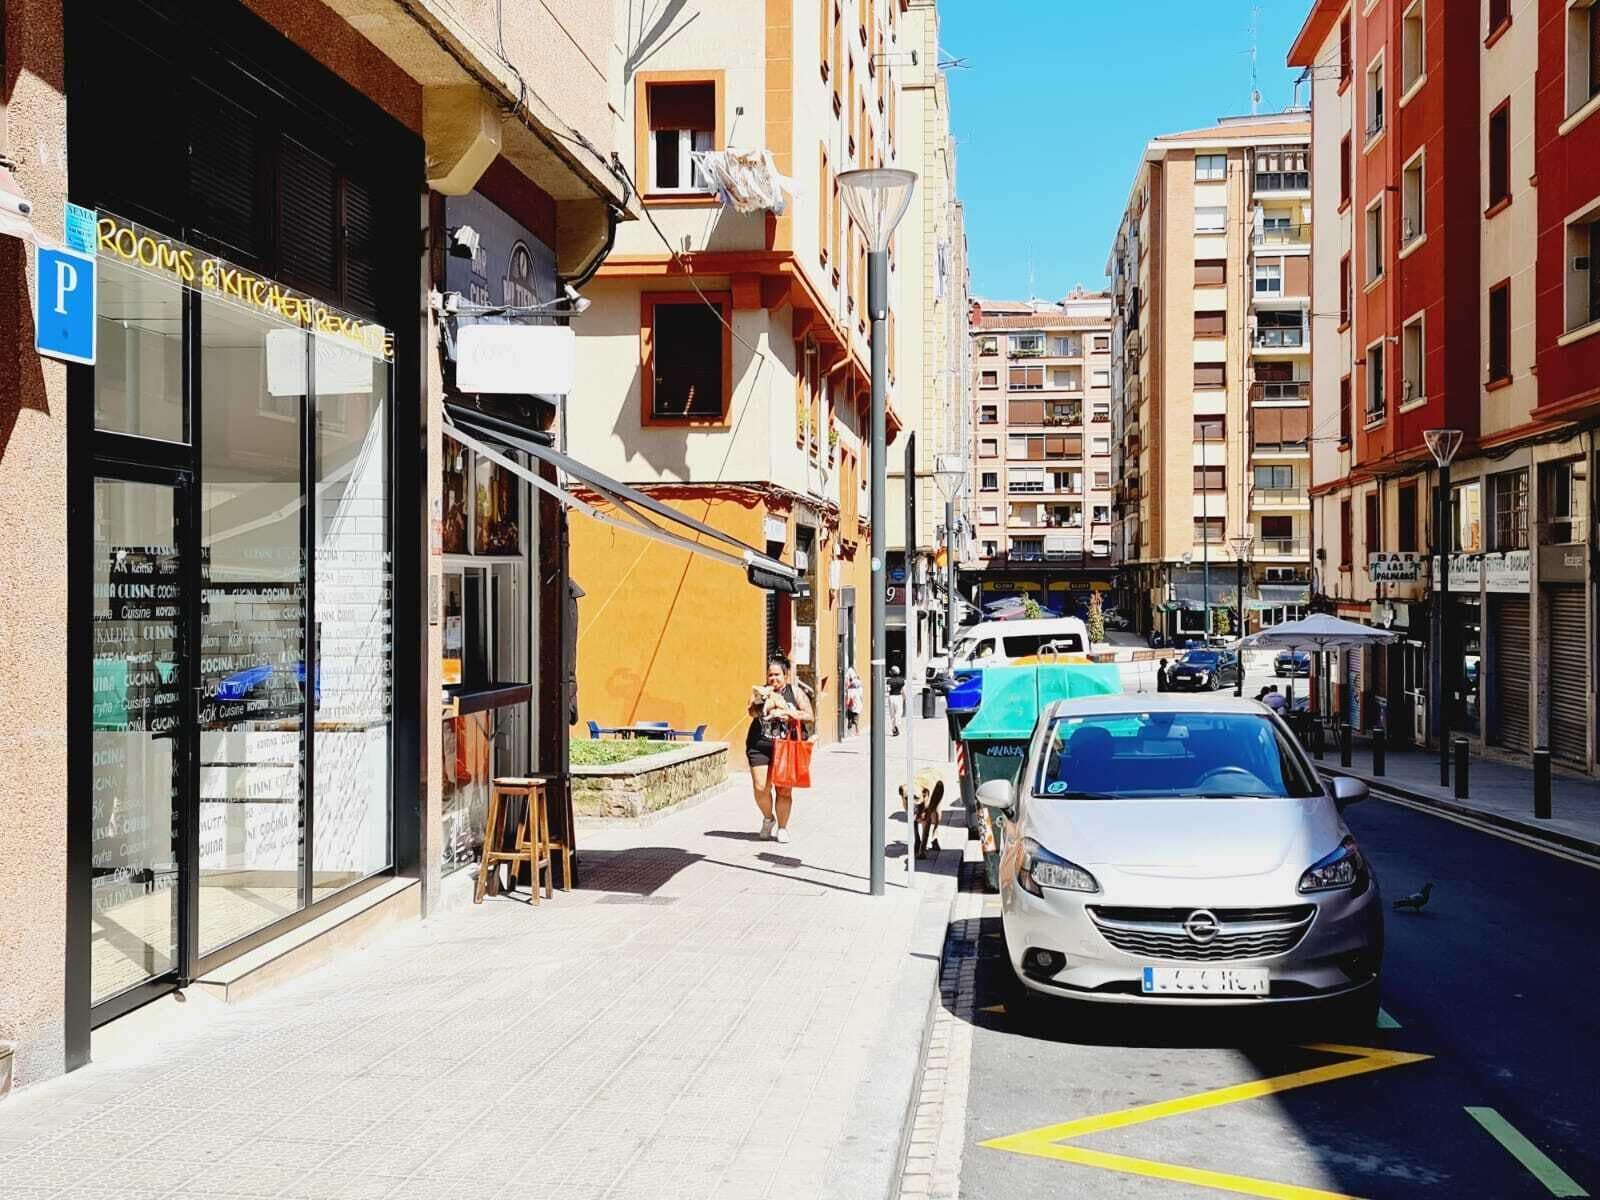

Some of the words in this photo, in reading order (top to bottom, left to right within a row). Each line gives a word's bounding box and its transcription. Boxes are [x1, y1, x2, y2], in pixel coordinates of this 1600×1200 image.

[96, 218, 194, 281] ROOMS
[201, 258, 218, 289] &
[220, 268, 312, 323] KITCHEN
[54, 260, 77, 315] P
[1377, 554, 1413, 562] BAR
[1387, 563, 1404, 571] LAS
[117, 583, 155, 599] CUISINE
[121, 605, 151, 619] Cuisine
[120, 696, 151, 710] Cuisine
[219, 702, 245, 718] Cuisine
